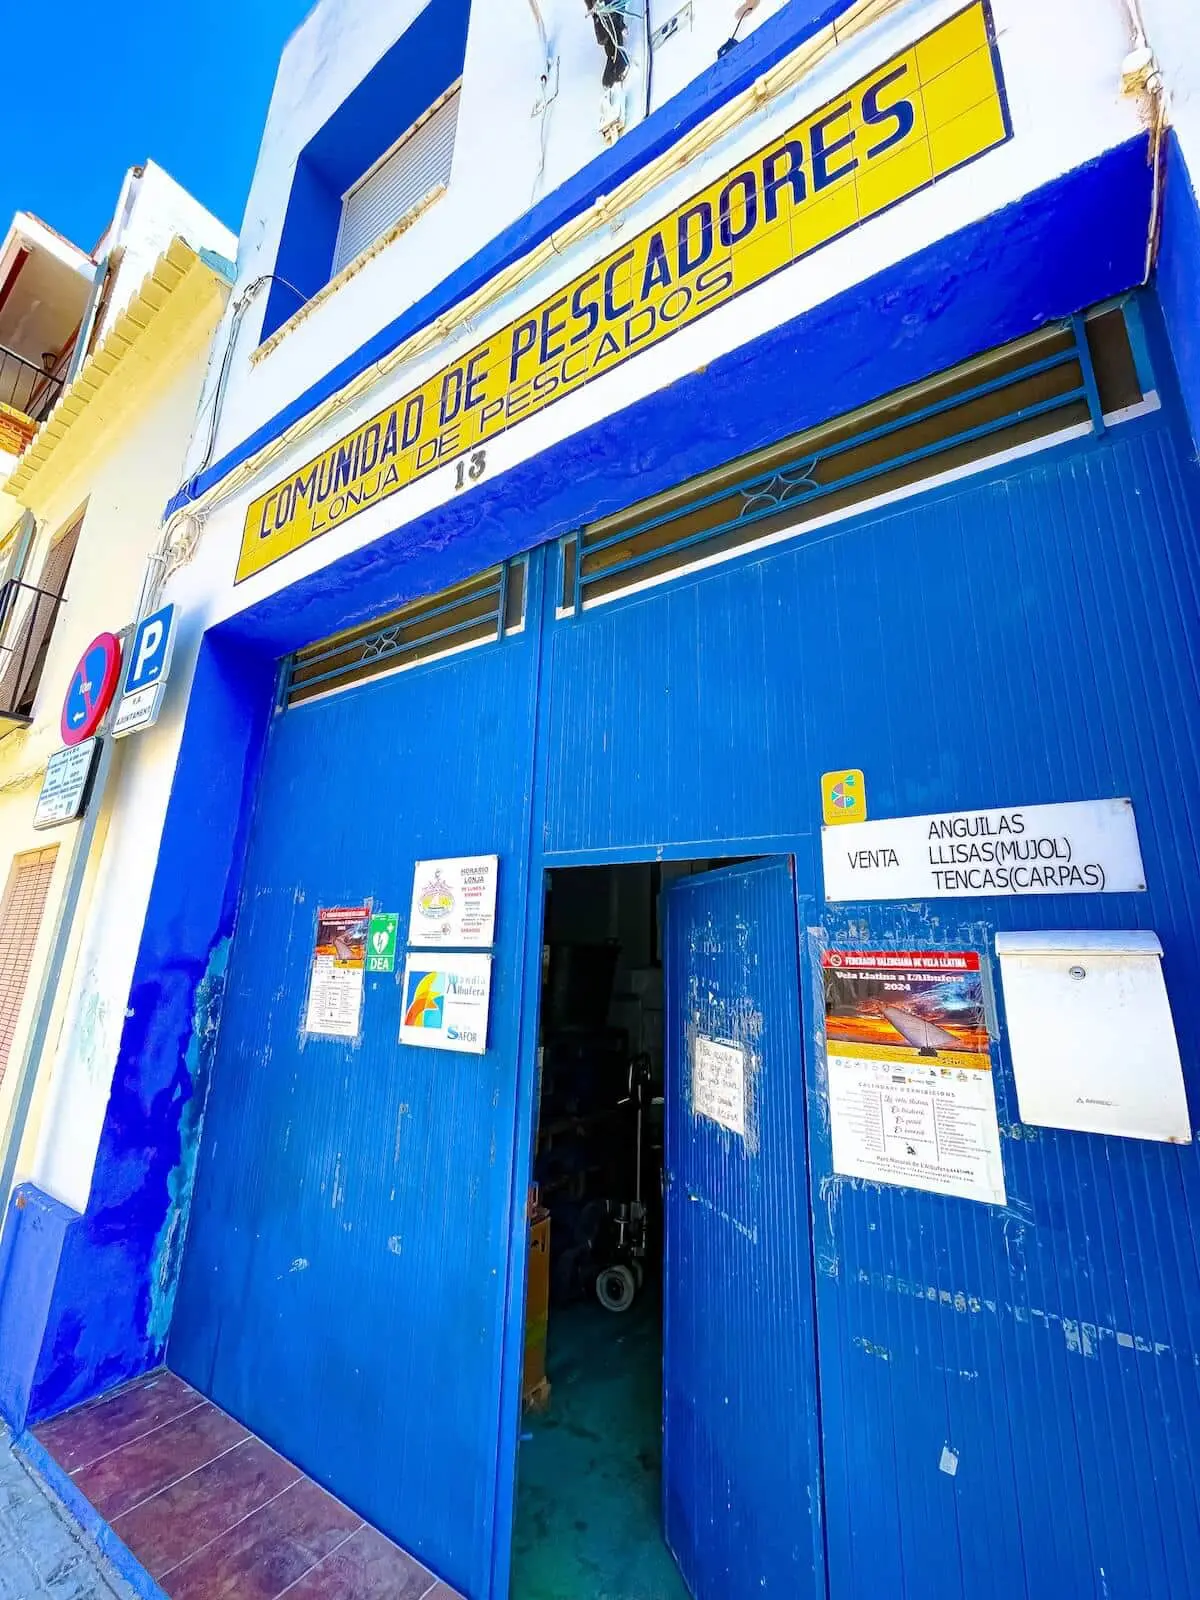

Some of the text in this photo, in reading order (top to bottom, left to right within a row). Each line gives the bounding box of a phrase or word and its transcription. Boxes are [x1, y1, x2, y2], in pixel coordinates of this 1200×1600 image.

[260, 63, 915, 539] COMUNIDAD DE PESCADORES
[311, 262, 733, 533] LONJA DE PESCADOS
[454, 449, 488, 491] 13
[133, 619, 164, 682] P
[928, 814, 1025, 840] ANGUILAS
[848, 848, 899, 870] VENTA
[929, 837, 1073, 866] LLISAS(MUJOL)
[461, 866, 489, 875] HORARIO
[932, 863, 1106, 891] TENCAS(CARPAS)
[370, 957, 389, 970] DEA
[923, 958, 938, 969] VELA
[939, 958, 967, 969] LLATINA
[835, 971, 858, 980] Vela
[859, 972, 896, 981] Llatina
[907, 973, 965, 983] L'Albufera
[884, 983, 911, 991] 2024
[447, 1025, 478, 1042] SAFOR
